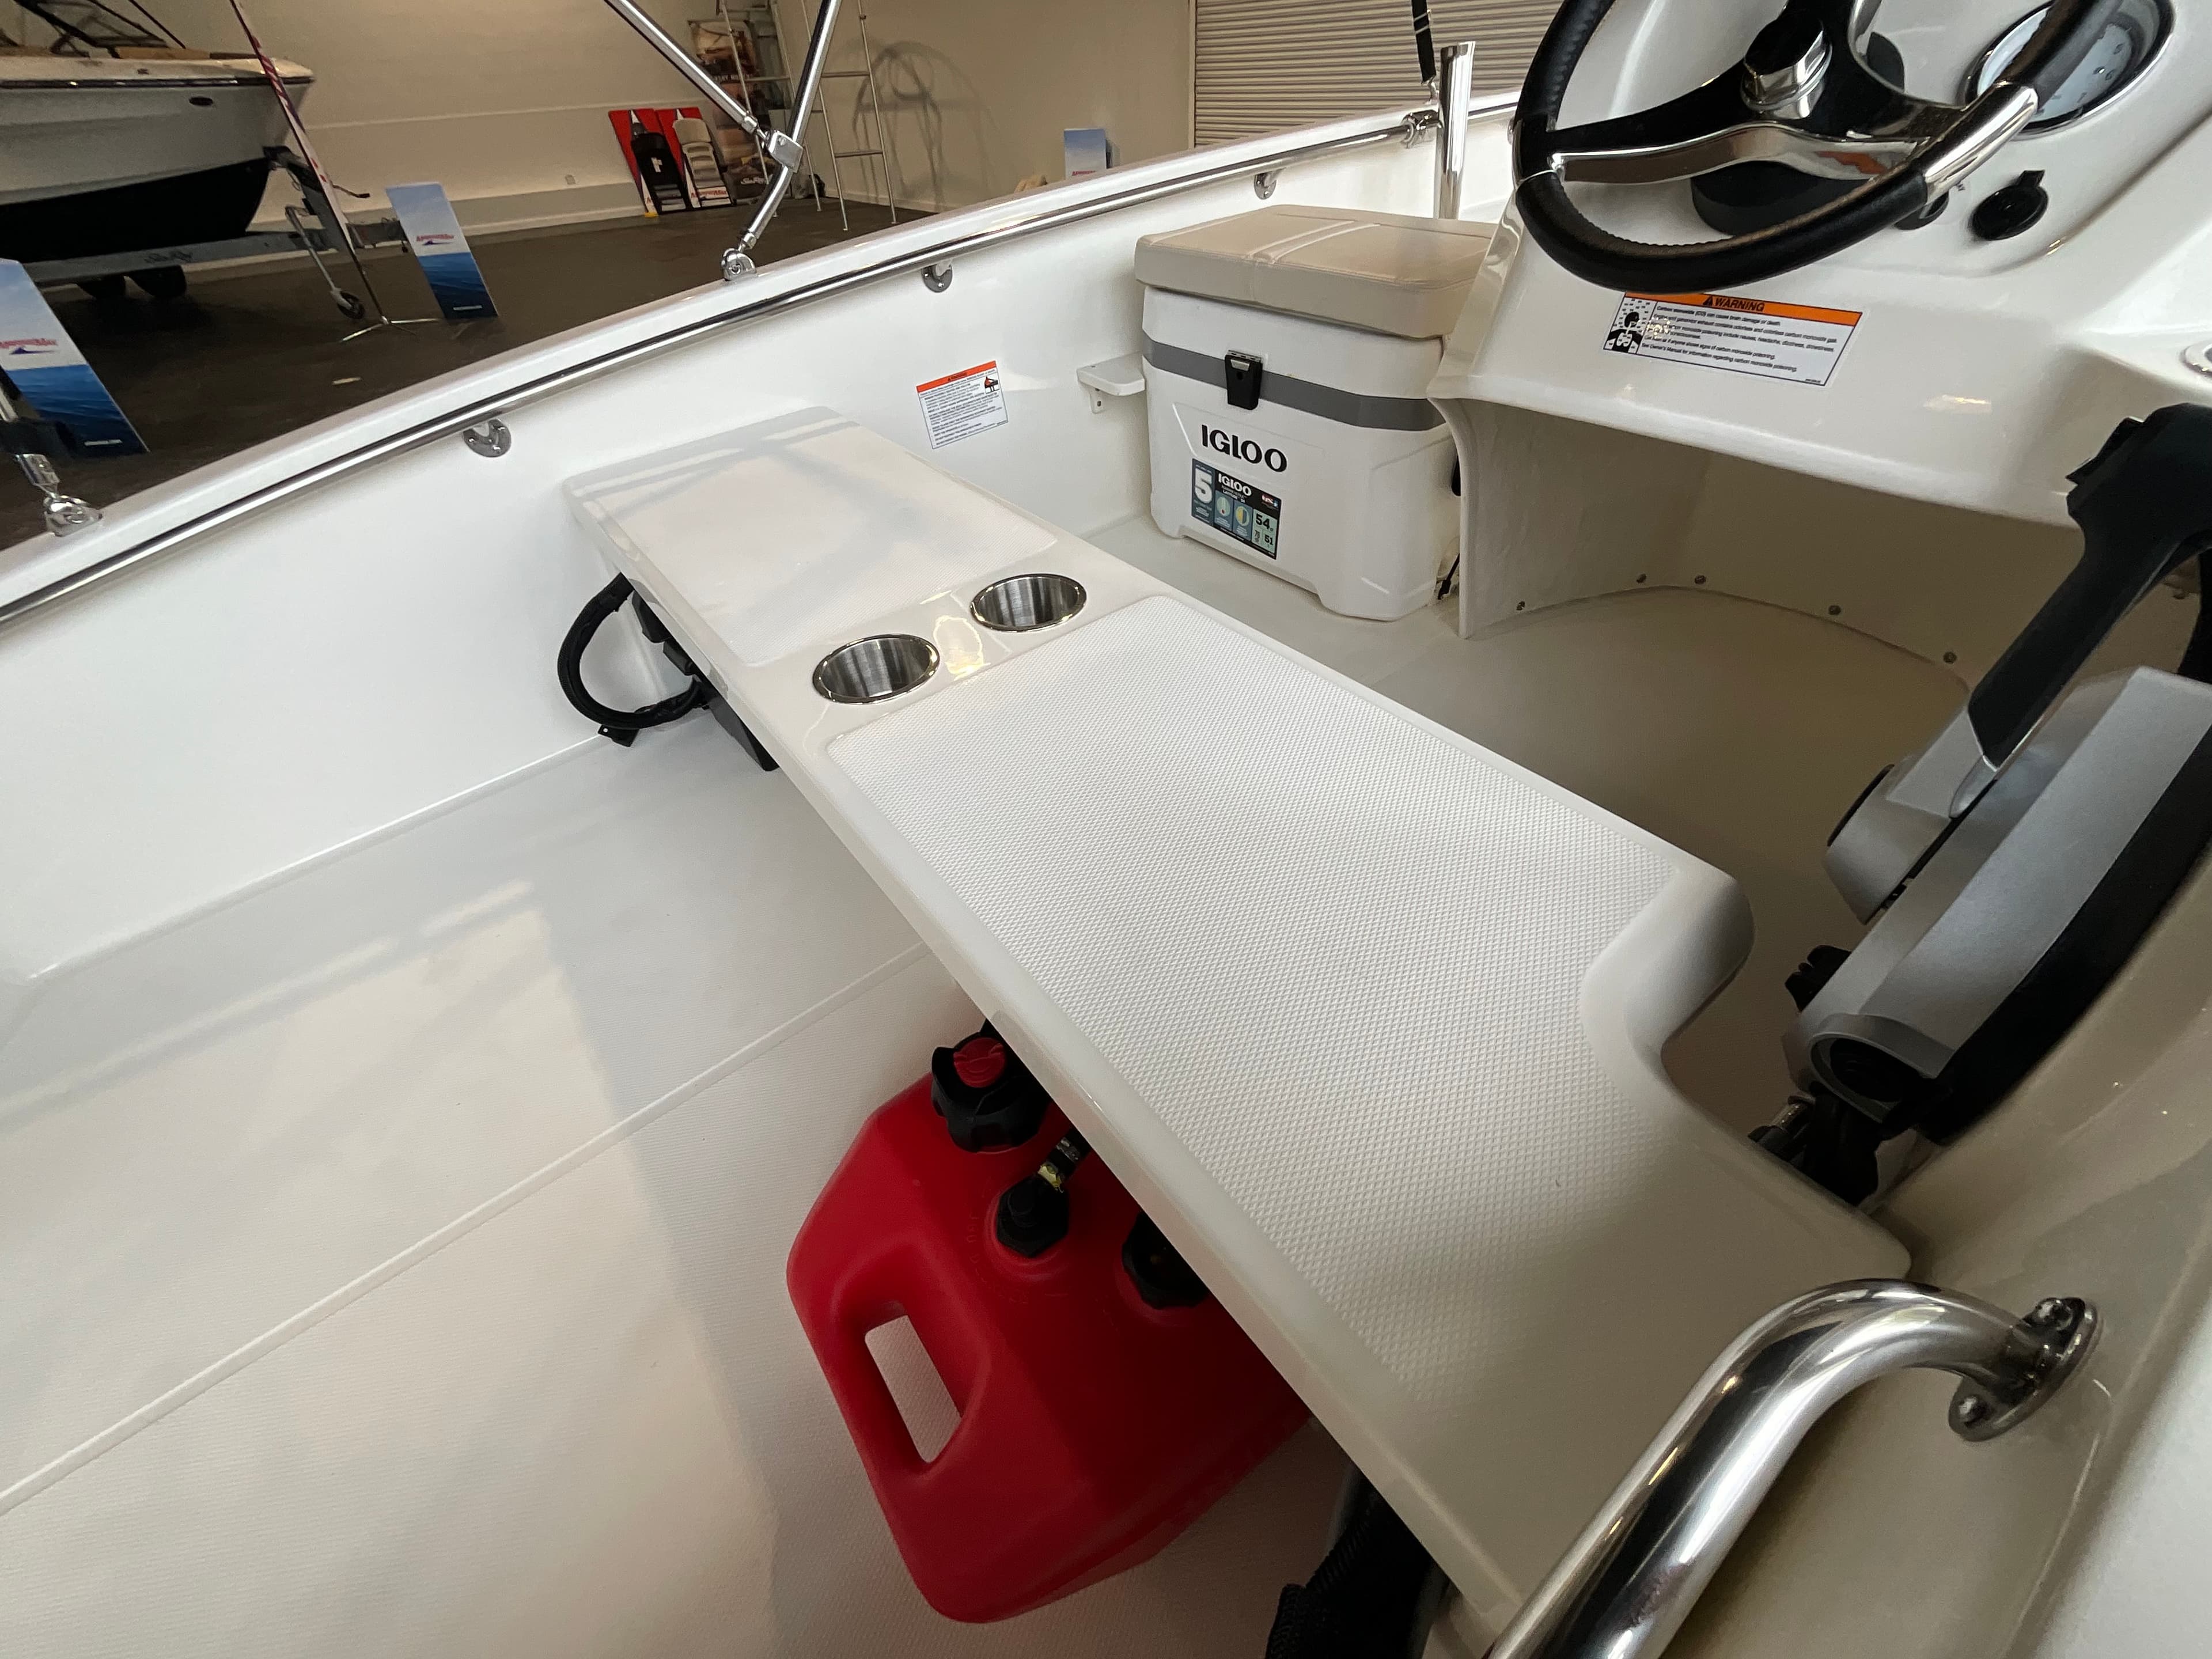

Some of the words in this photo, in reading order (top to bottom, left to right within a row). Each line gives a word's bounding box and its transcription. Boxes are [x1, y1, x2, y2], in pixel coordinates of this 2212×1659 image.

[1714, 298, 1765, 312] WARNING
[1202, 425, 1287, 472] IGLOO
[1195, 468, 1213, 504] 5
[1218, 473, 1252, 497] IGLOO
[1255, 513, 1270, 530] 54
[1264, 533, 1274, 546] 51
